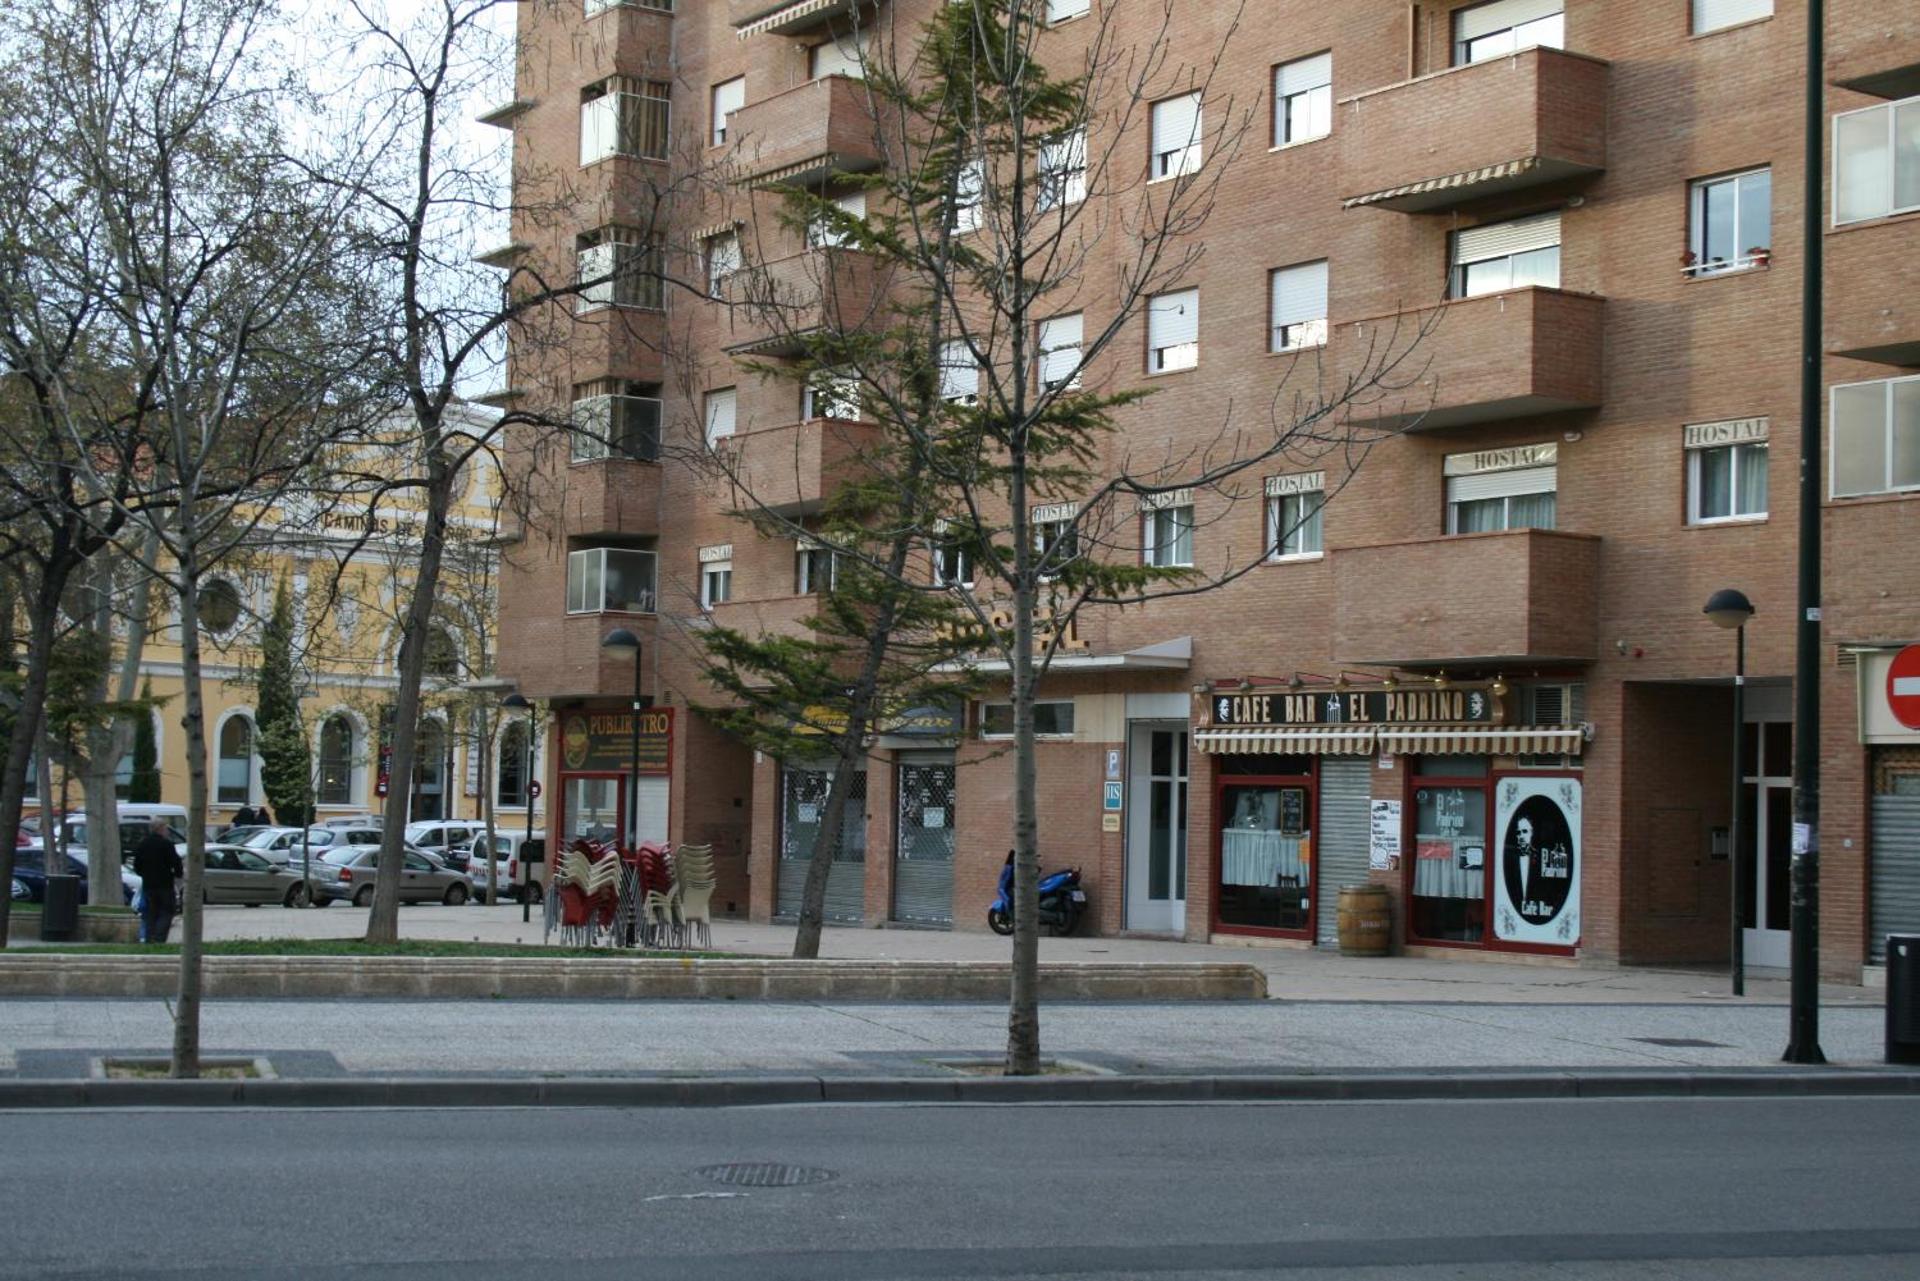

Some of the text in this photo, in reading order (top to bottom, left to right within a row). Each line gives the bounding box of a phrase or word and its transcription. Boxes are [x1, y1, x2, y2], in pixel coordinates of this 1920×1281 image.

[1688, 418, 1769, 445] HOSTAL
[1474, 446, 1539, 469] HOSTAL
[1268, 472, 1326, 493] HOSTAL
[1233, 692, 1464, 723] CAFE BAR EL PADRINO
[589, 713, 669, 735] PUBLIRTRO
